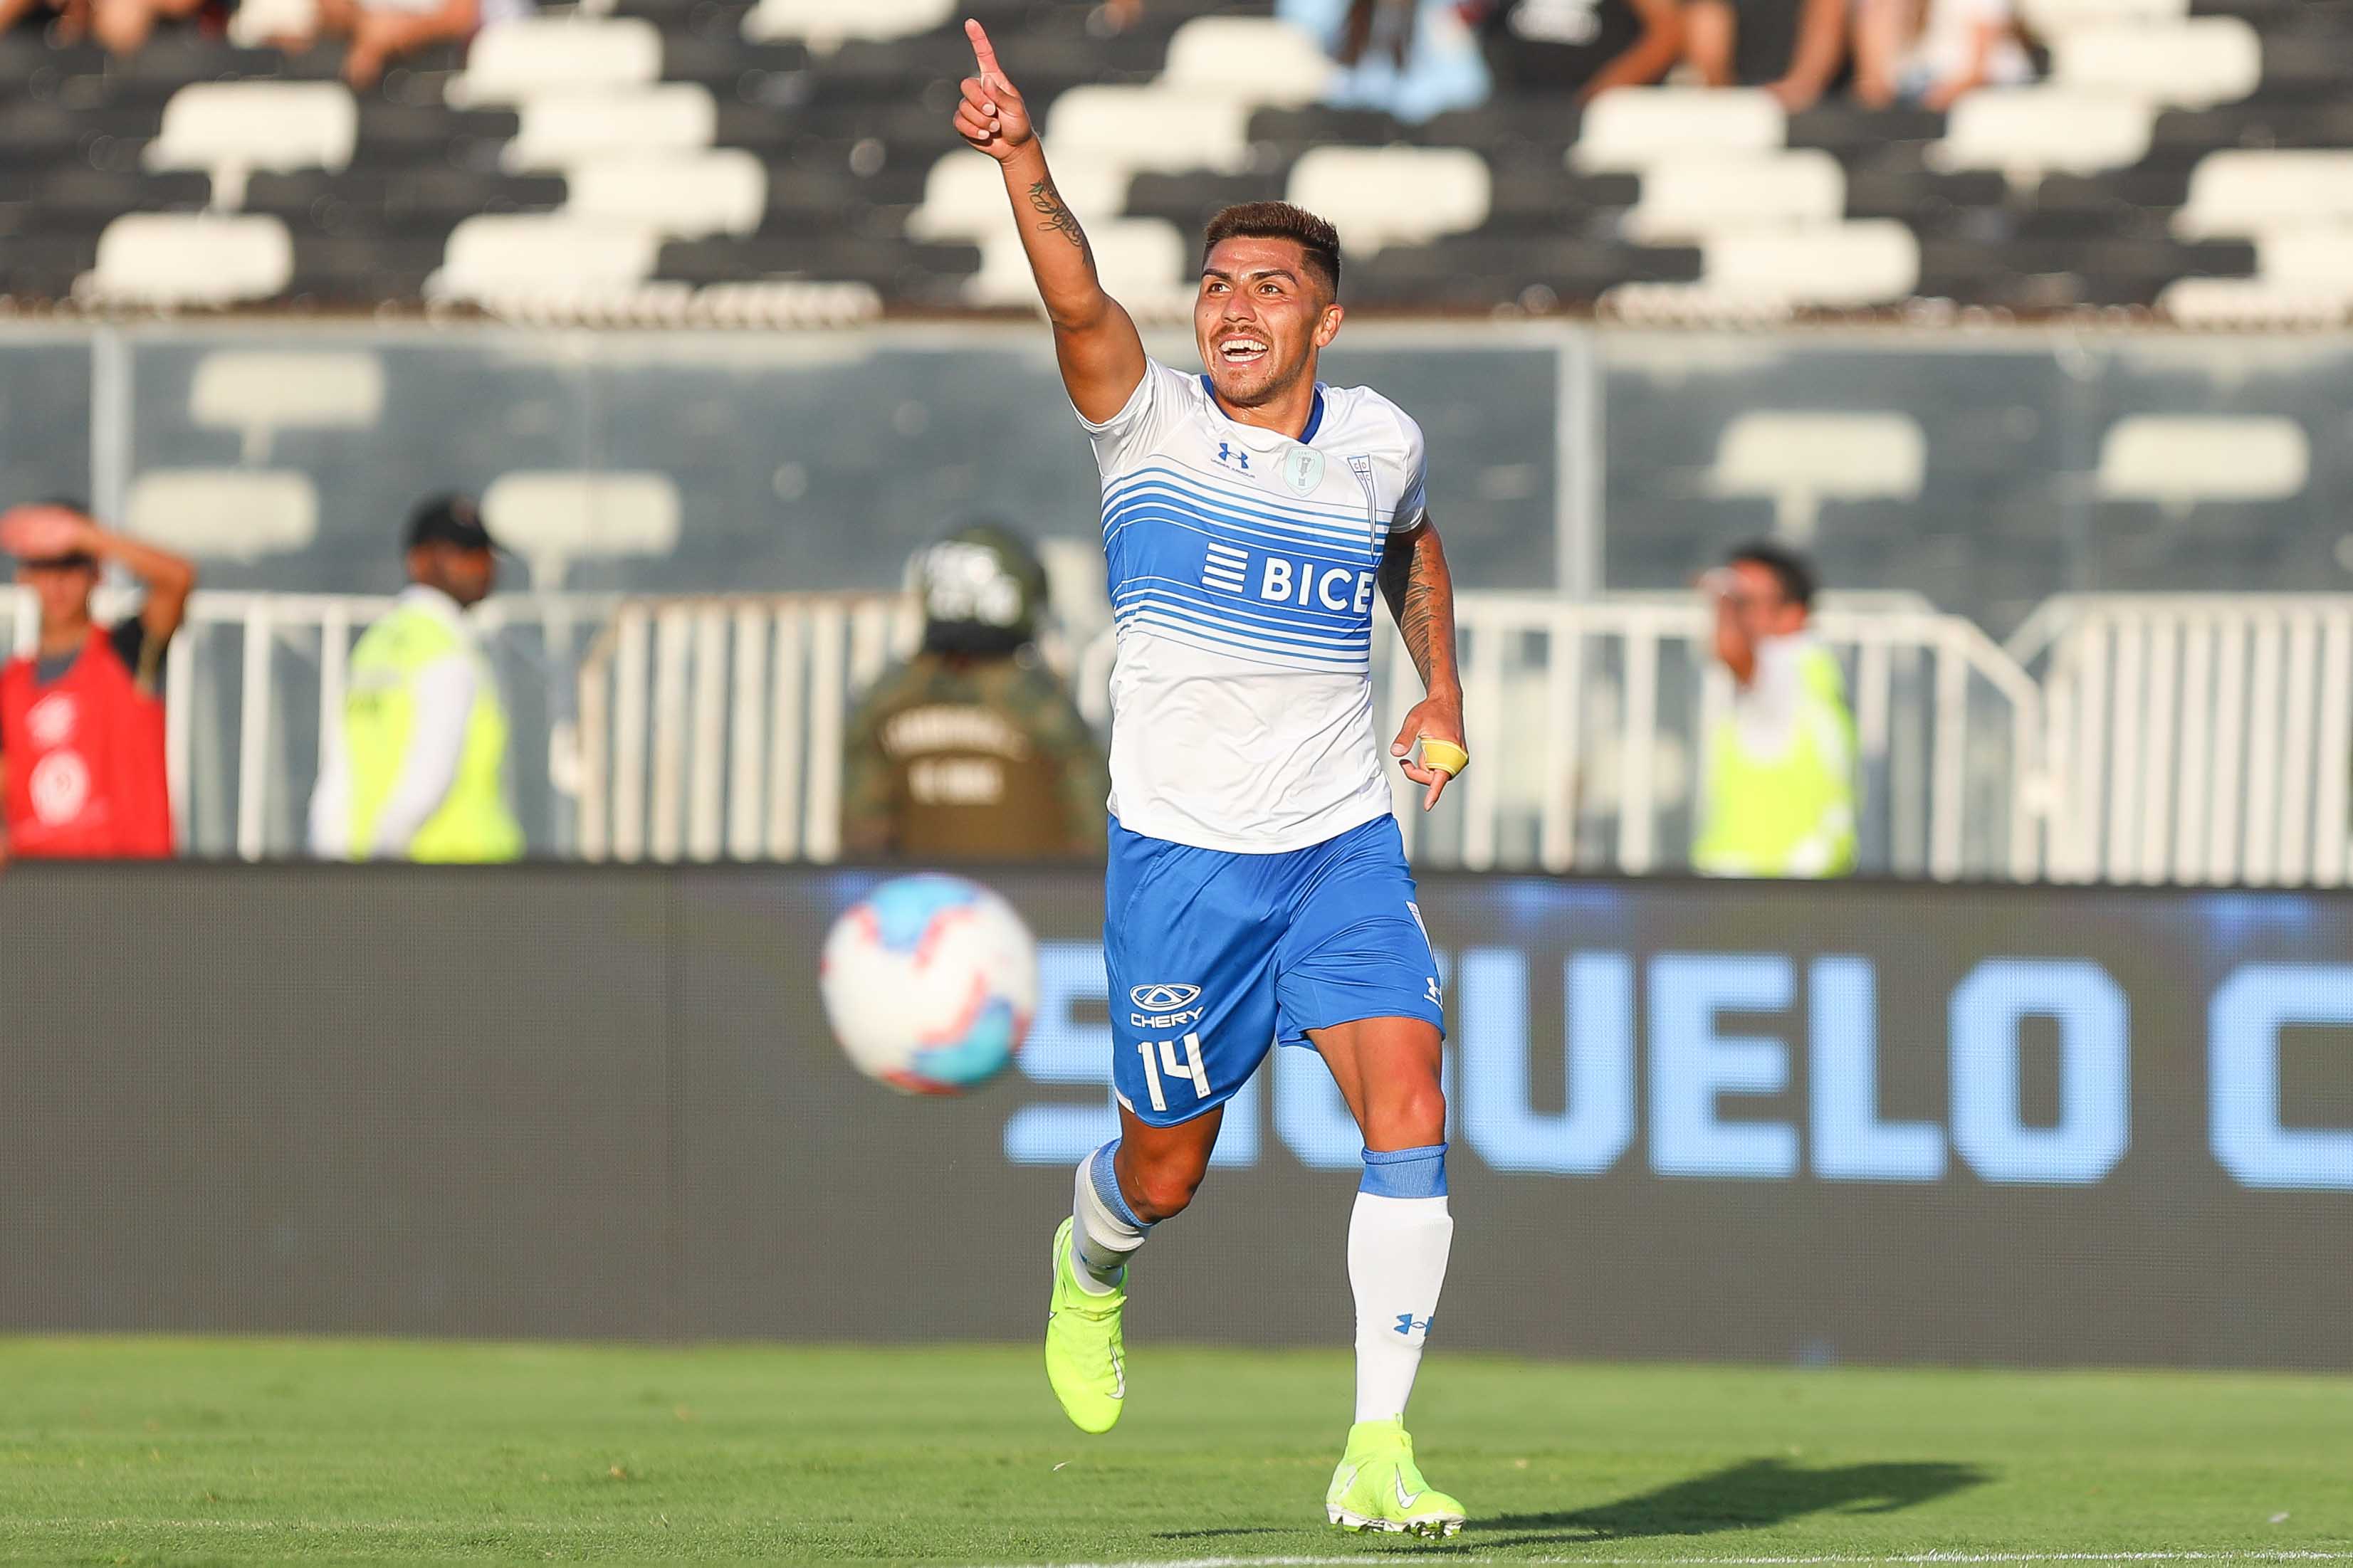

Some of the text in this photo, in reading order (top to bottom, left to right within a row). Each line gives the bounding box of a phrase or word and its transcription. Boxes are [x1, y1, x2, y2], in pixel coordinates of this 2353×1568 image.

[1260, 557, 1374, 613] BICE
[1131, 1006, 1204, 1028] CHERY
[1138, 1031, 1210, 1111] 14
